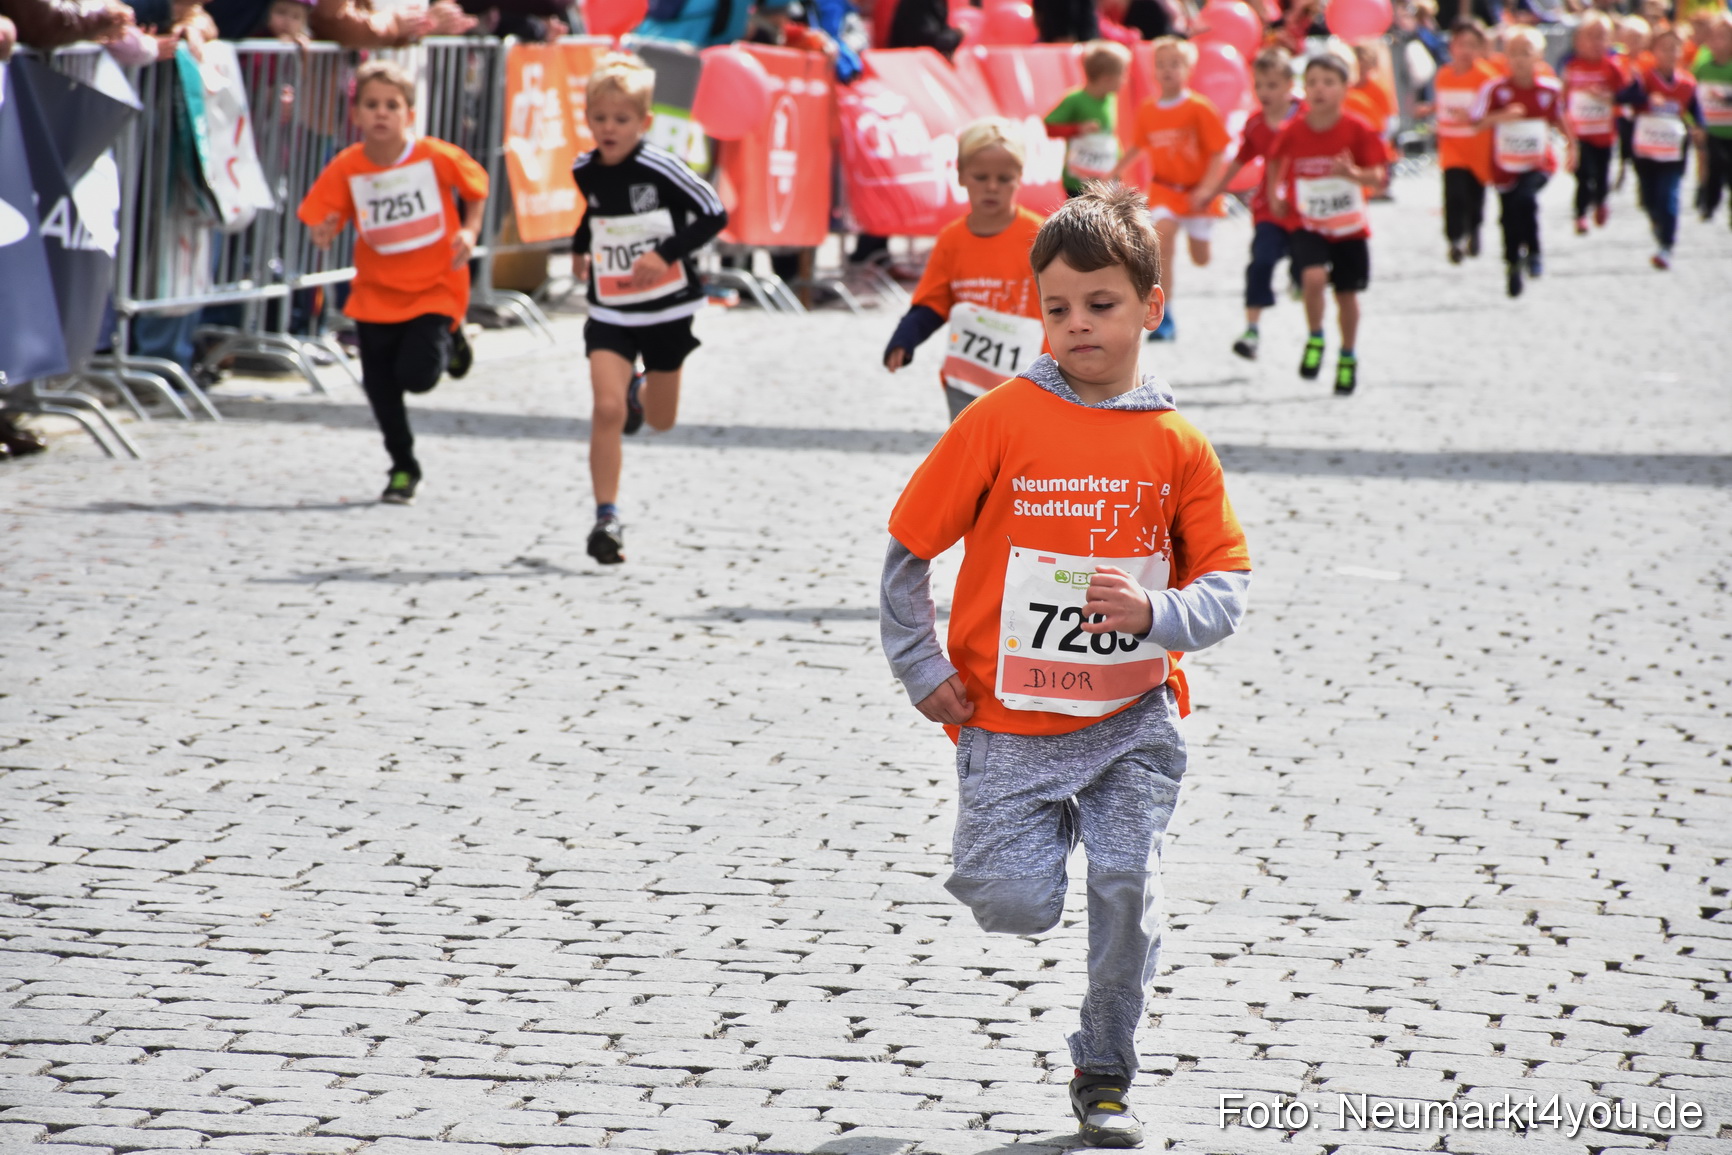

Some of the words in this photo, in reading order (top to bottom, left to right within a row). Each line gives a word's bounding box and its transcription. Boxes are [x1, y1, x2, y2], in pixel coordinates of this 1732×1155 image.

[368, 188, 426, 224] 7251
[962, 330, 1021, 371] 7211
[1012, 475, 1129, 492] Neumarkter
[1014, 499, 1106, 520] Stadtlauf
[1024, 668, 1093, 691] DIOR
